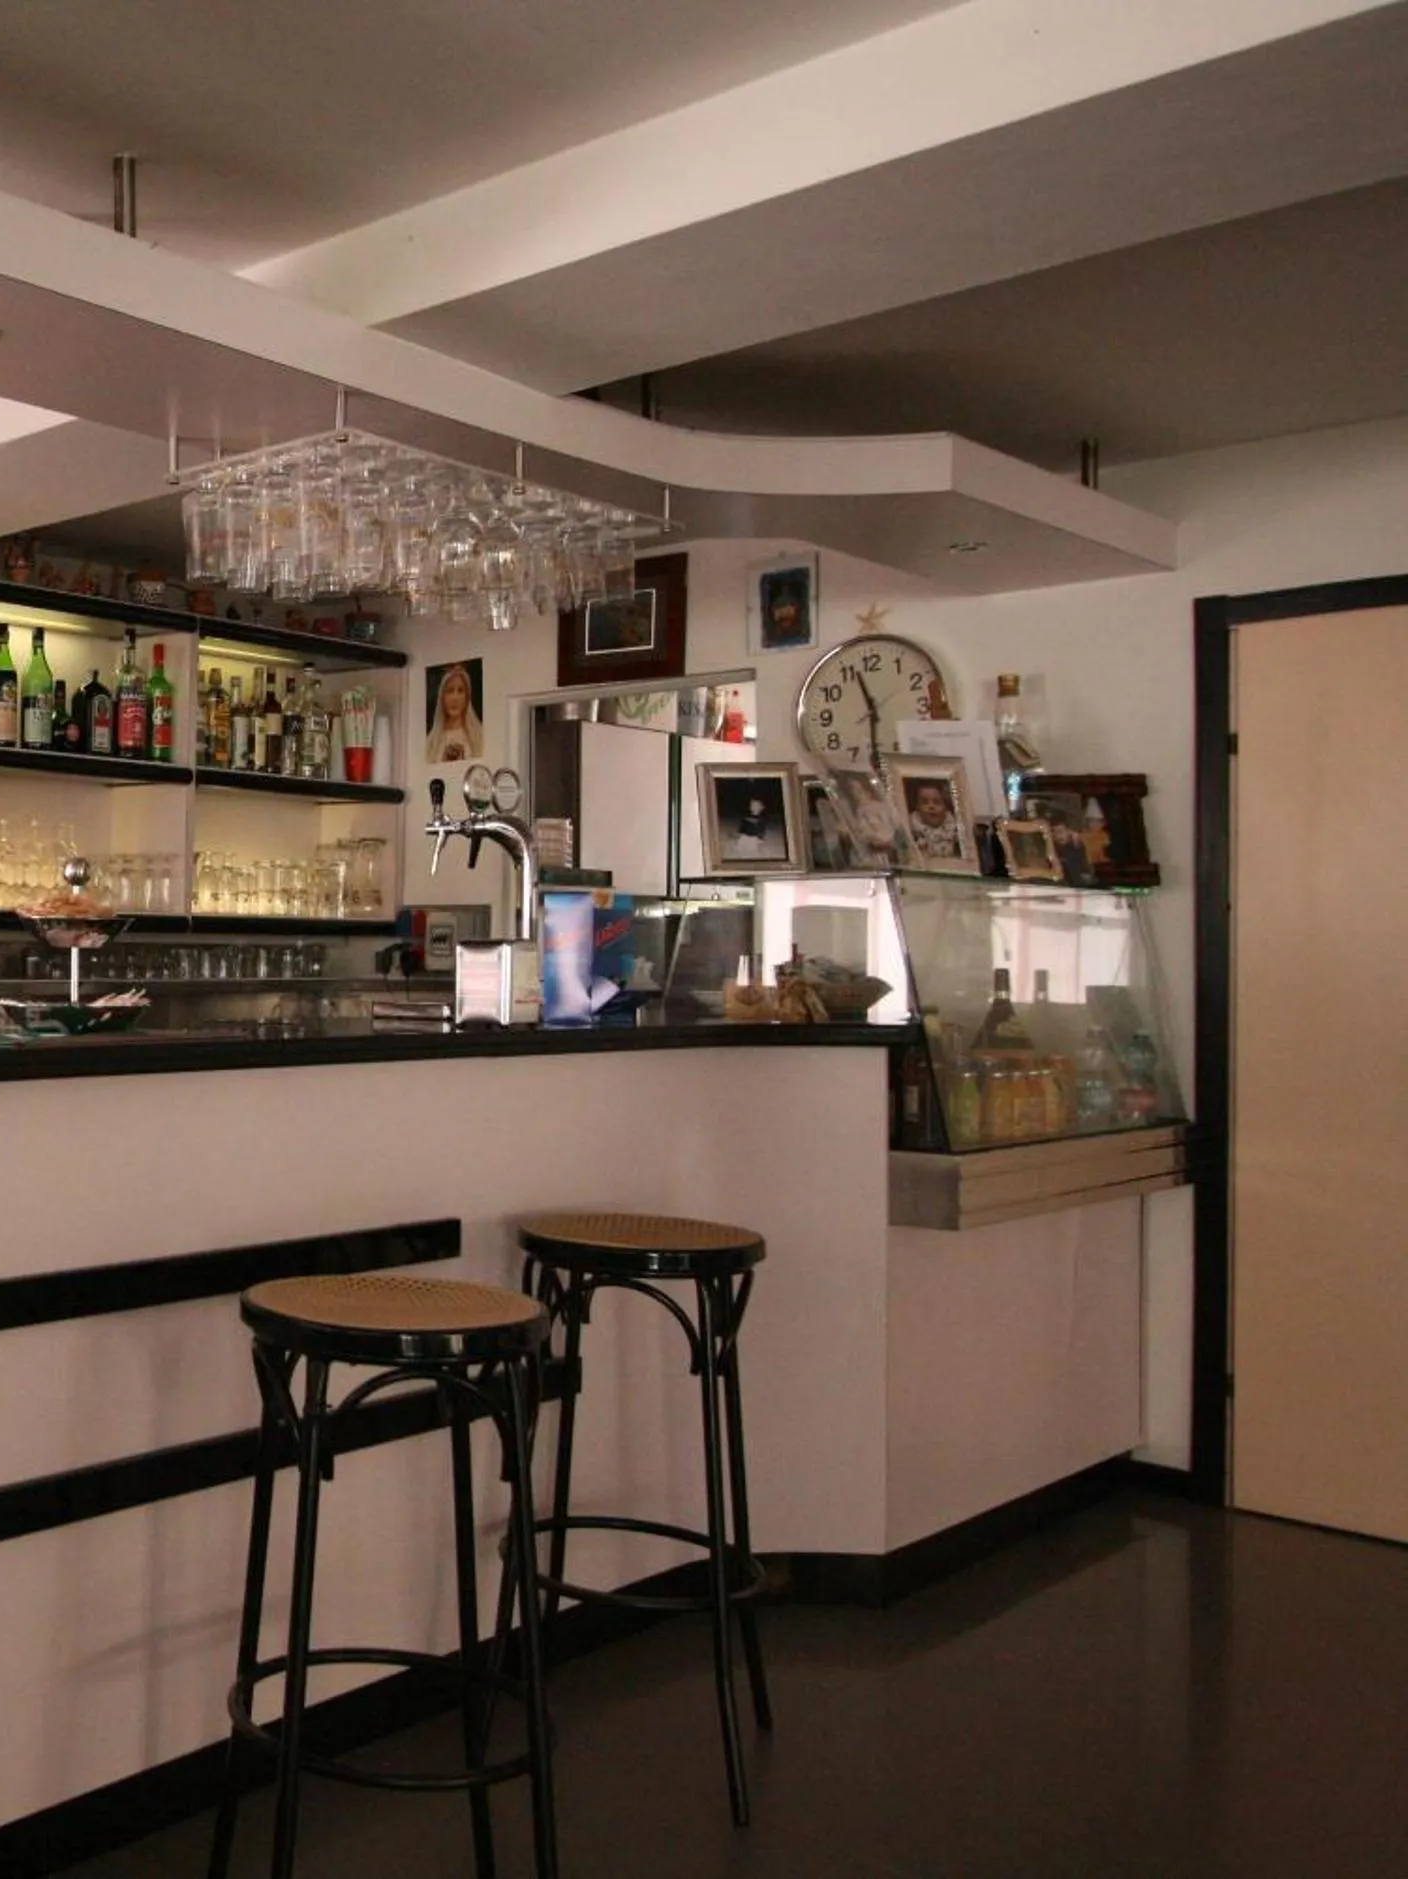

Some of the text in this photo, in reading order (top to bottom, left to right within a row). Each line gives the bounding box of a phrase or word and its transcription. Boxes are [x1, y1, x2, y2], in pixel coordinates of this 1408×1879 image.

[862, 654, 882, 672] 12
[894, 658, 902, 675] 1
[840, 665, 856, 683] 11
[910, 673, 923, 691] 2
[821, 684, 842, 702] 10
[917, 696, 930, 714] 3
[820, 709, 833, 727] 9
[828, 732, 840, 751] 8
[847, 747, 860, 762] 7
